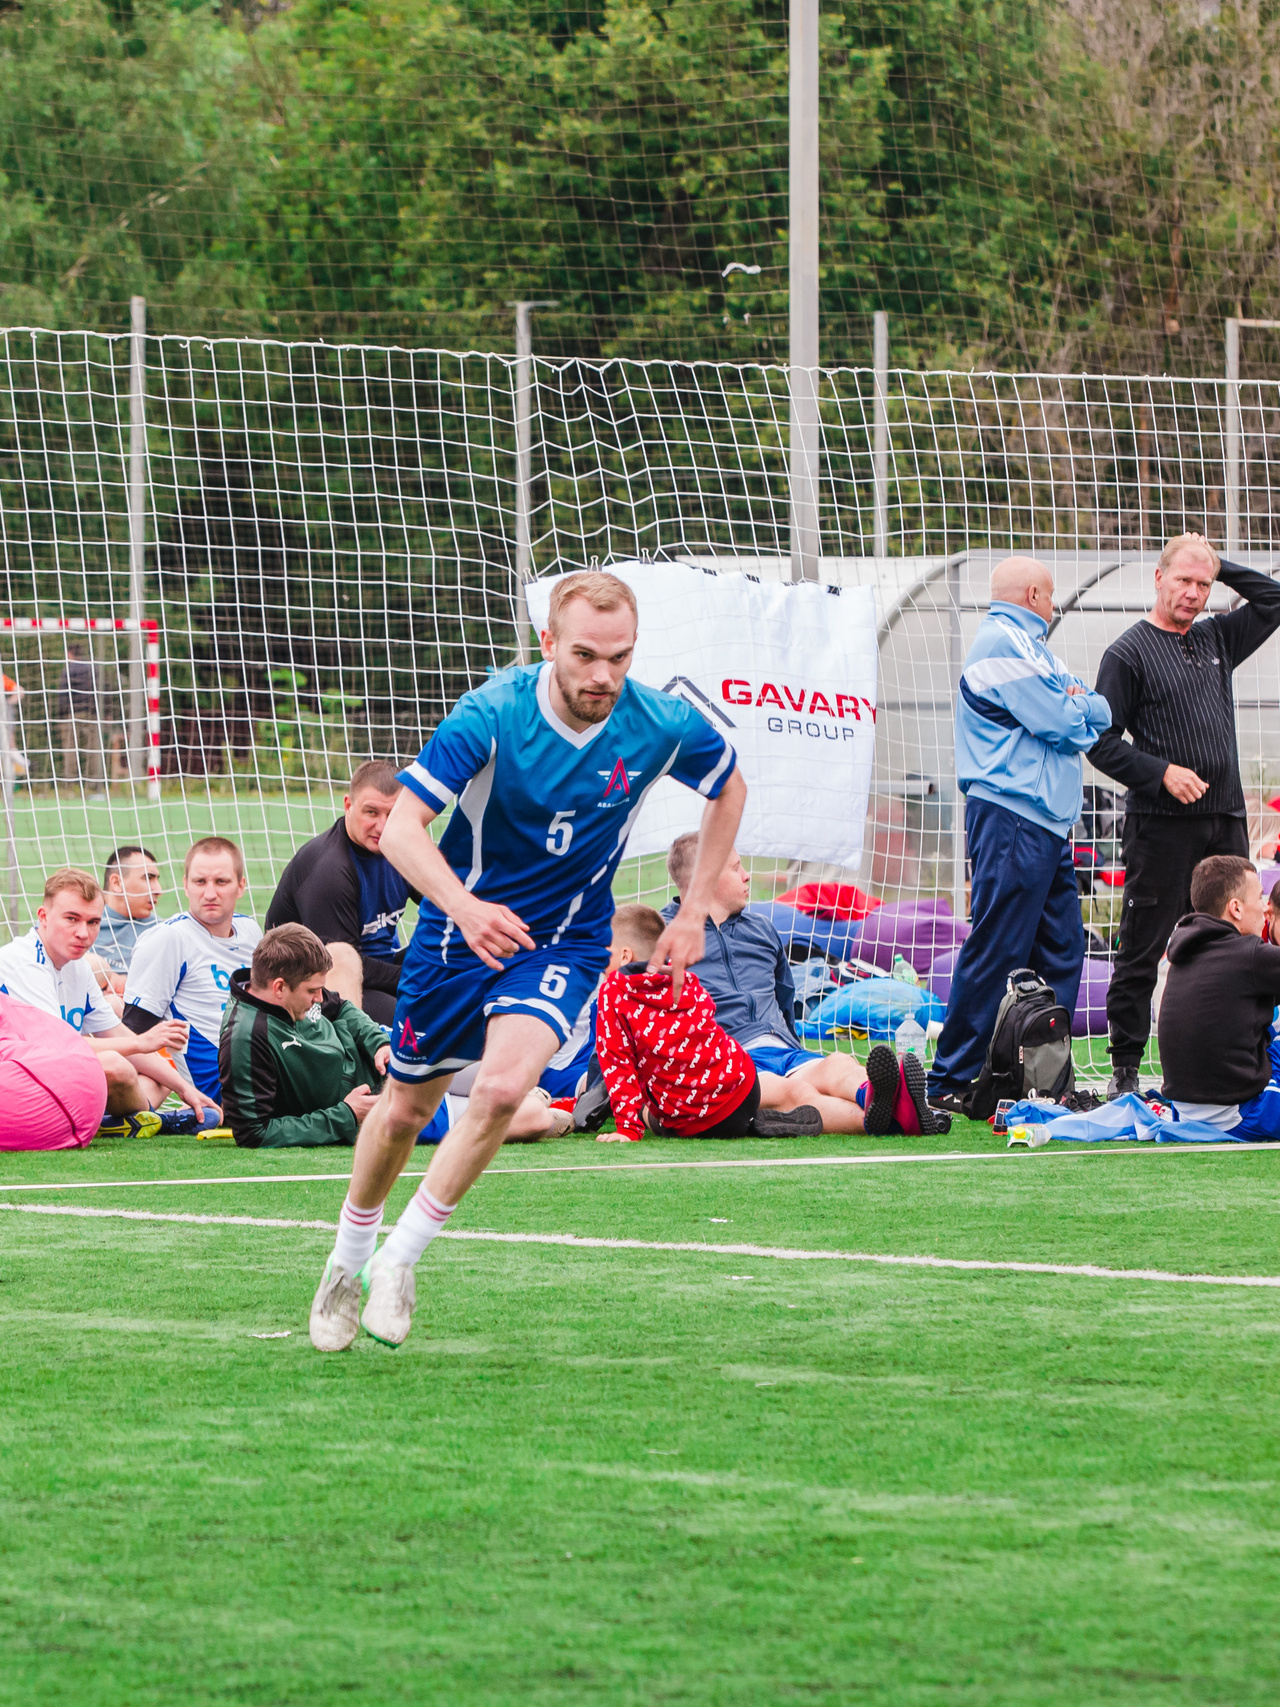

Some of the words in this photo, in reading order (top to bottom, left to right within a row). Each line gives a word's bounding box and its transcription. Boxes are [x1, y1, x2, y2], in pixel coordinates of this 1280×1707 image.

[767, 717, 855, 742] GROUP
[546, 810, 576, 856] 5
[538, 963, 571, 1000] 5
